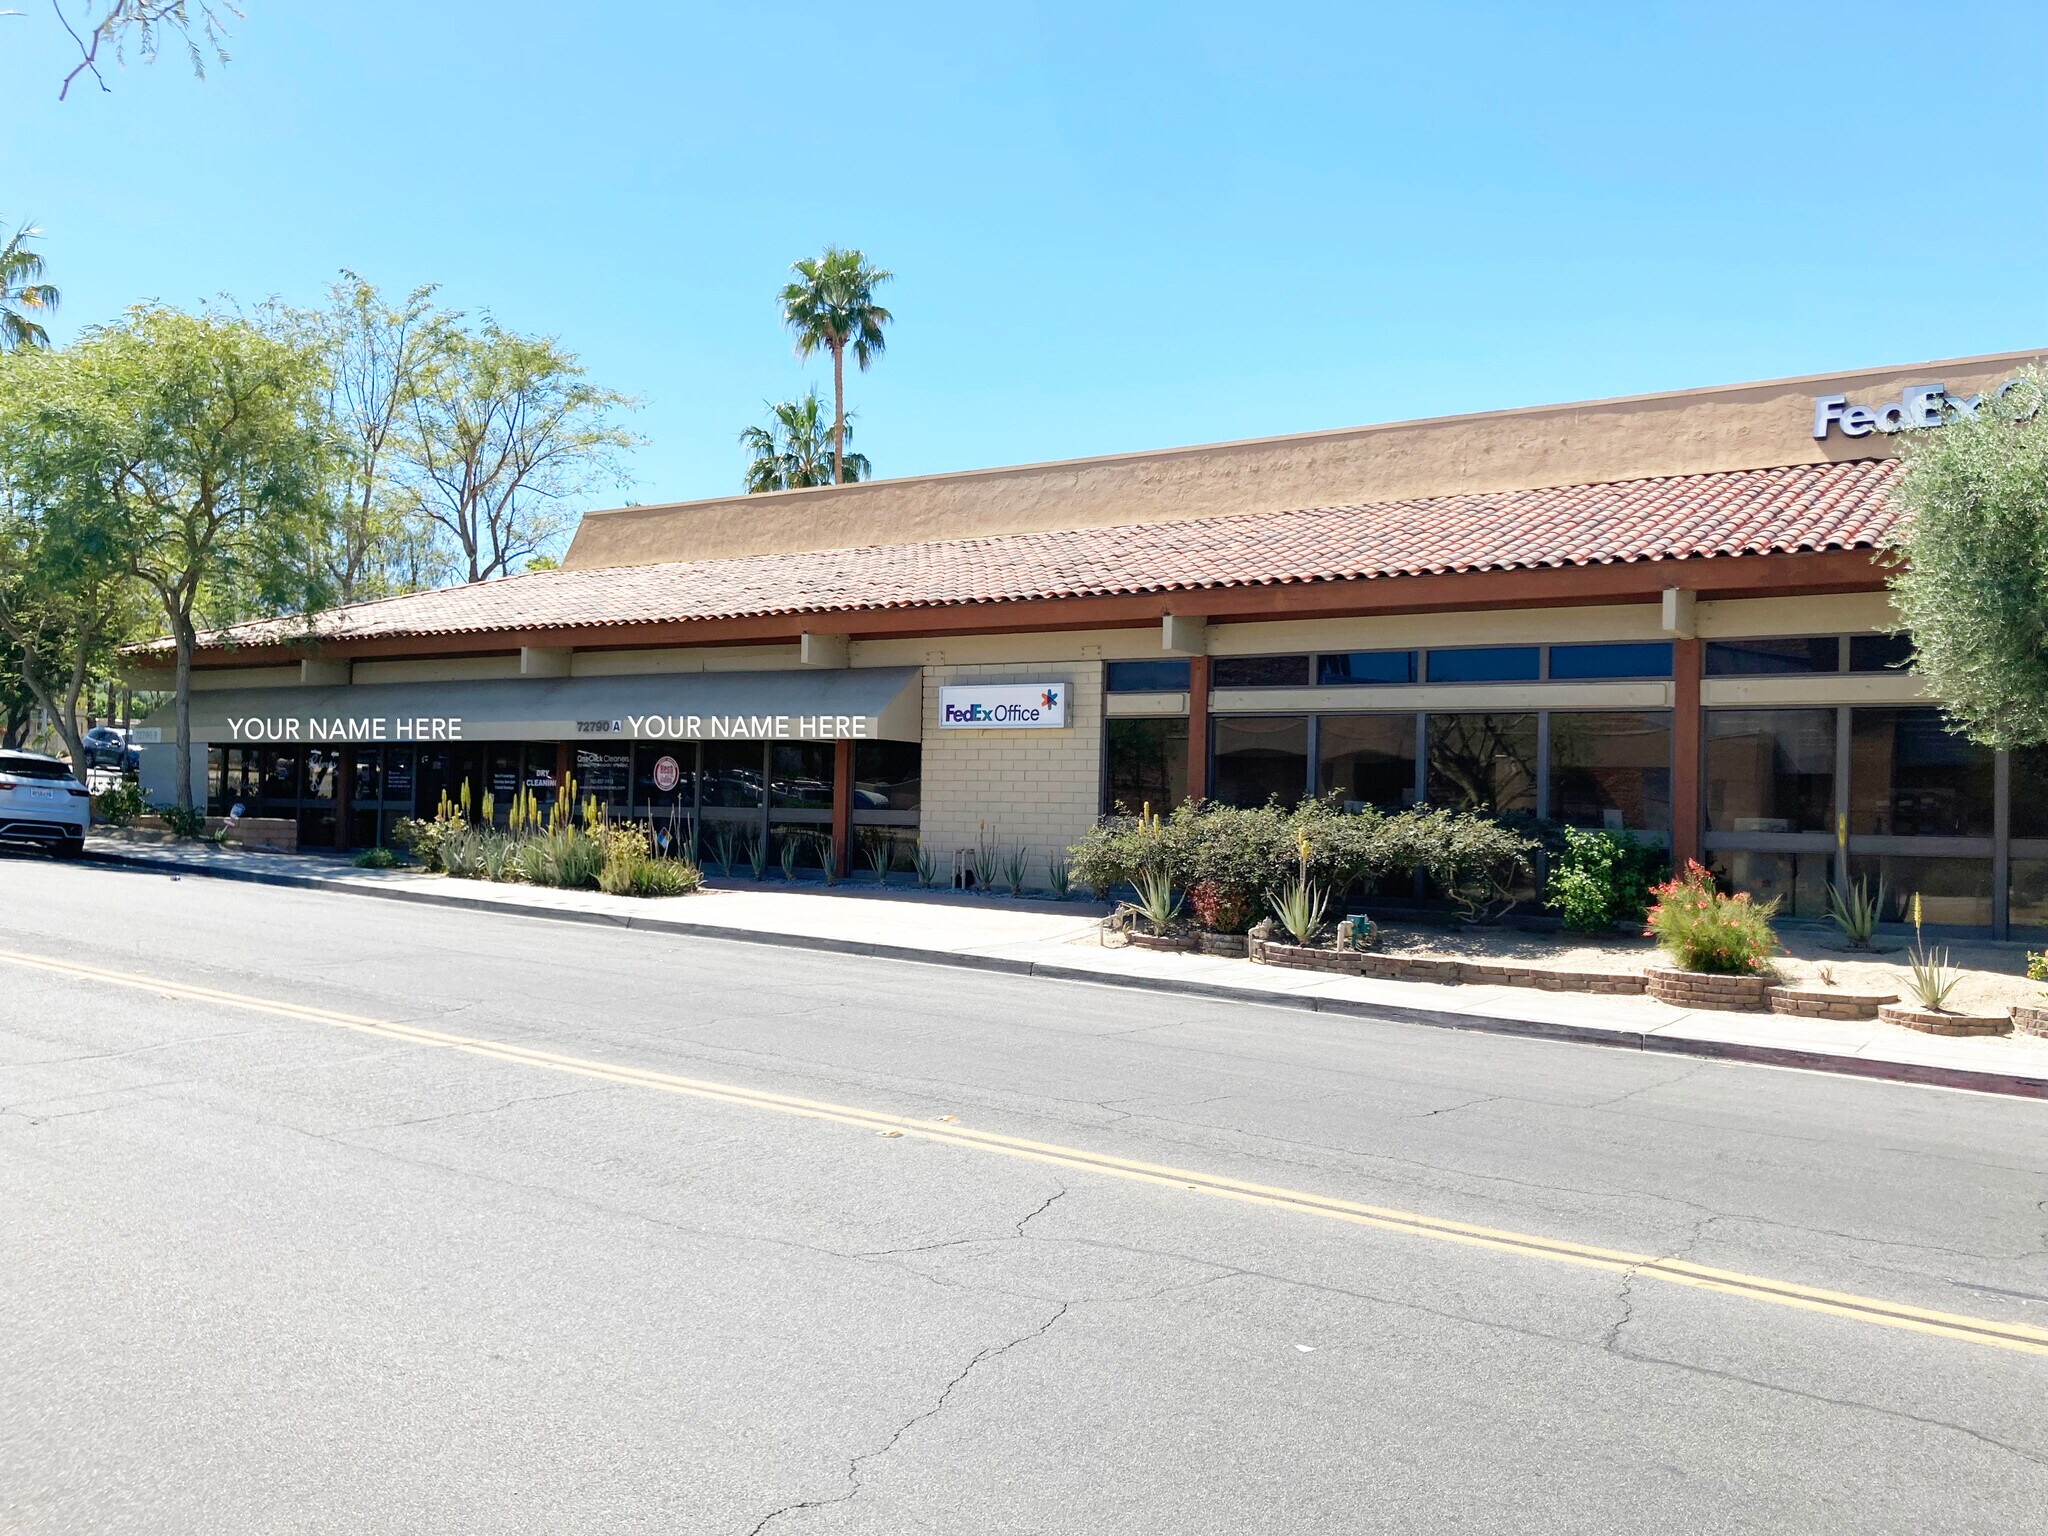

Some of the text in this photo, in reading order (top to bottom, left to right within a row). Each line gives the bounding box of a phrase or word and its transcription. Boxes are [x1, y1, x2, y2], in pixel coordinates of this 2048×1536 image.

[945, 704, 1040, 722] FedEx Office
[576, 721, 621, 732] 72790 A
[536, 769, 549, 777] DRY
